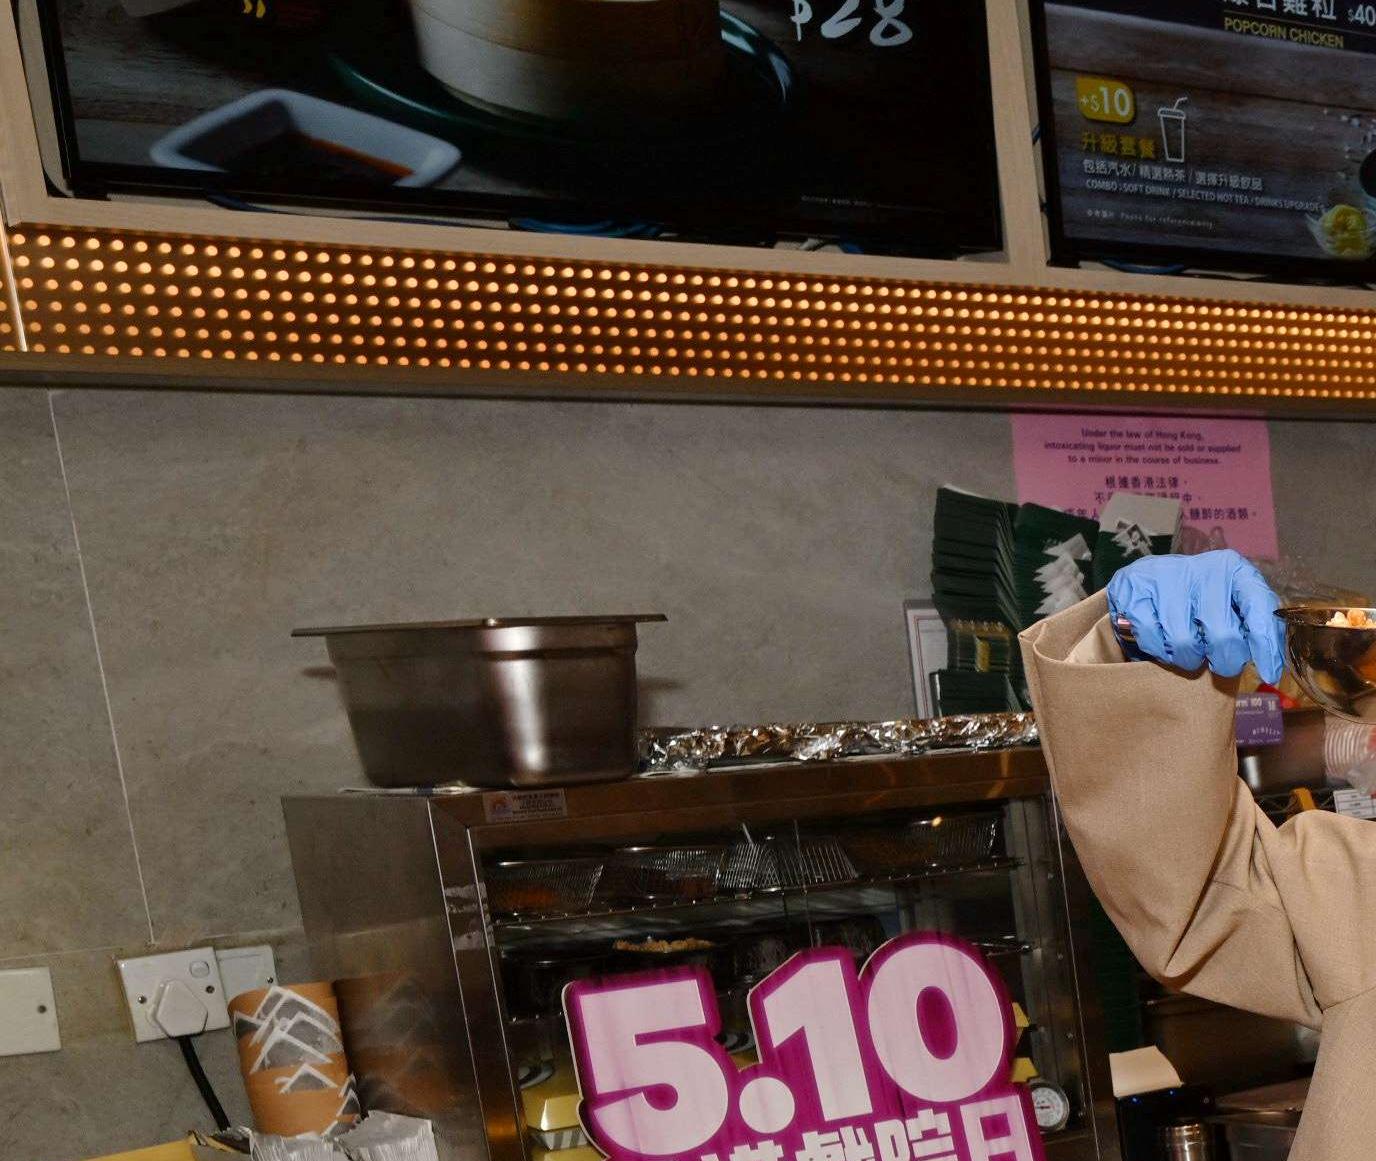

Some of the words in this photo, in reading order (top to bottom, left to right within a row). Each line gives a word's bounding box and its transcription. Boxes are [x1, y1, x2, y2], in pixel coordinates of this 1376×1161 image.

[1224, 17, 1287, 40] POPCORN
[1289, 27, 1344, 49] CHICKEN
[580, 943, 1004, 1156] 5.10
